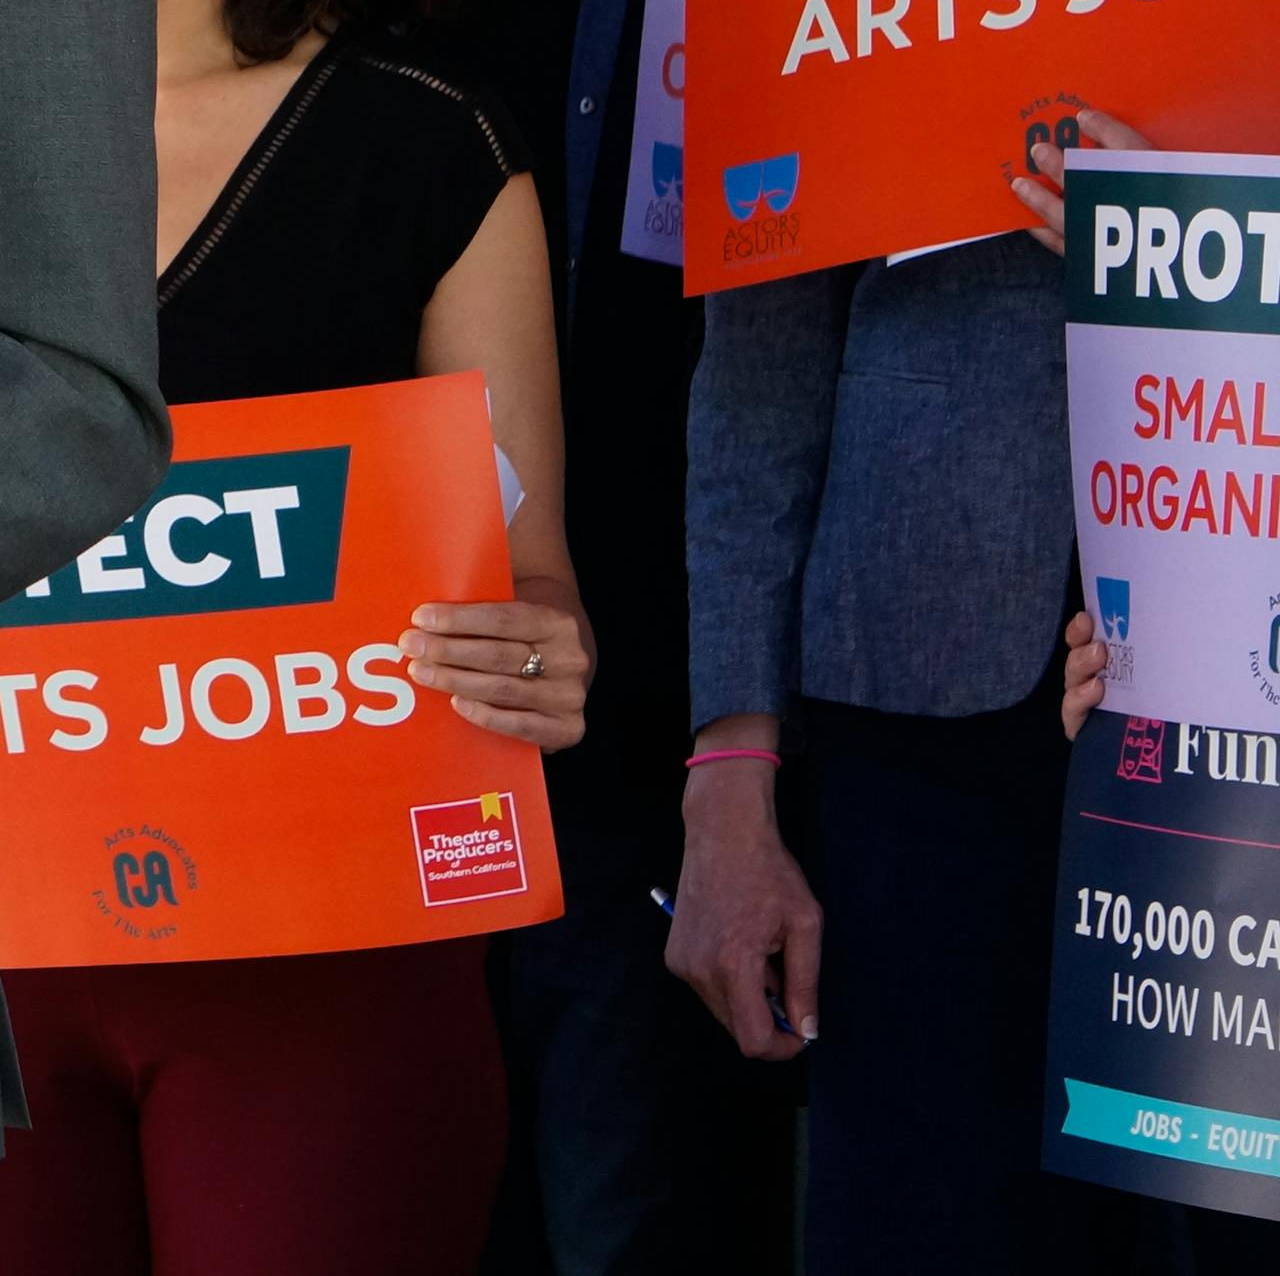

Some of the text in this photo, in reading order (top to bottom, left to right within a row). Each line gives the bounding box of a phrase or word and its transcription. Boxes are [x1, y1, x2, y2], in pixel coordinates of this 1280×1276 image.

[25, 485, 300, 598] ECT
[139, 643, 417, 746] JOBS
[103, 827, 136, 850] Arts
[423, 839, 514, 864] Producers
[428, 828, 500, 850] Theatre
[112, 850, 180, 909] CA
[427, 860, 517, 882] Southern California
[450, 859, 461, 869] of
[1074, 886, 1215, 961] 170,000
[1111, 970, 1280, 1052] HOW MA
[1130, 1107, 1183, 1146] JOBS
